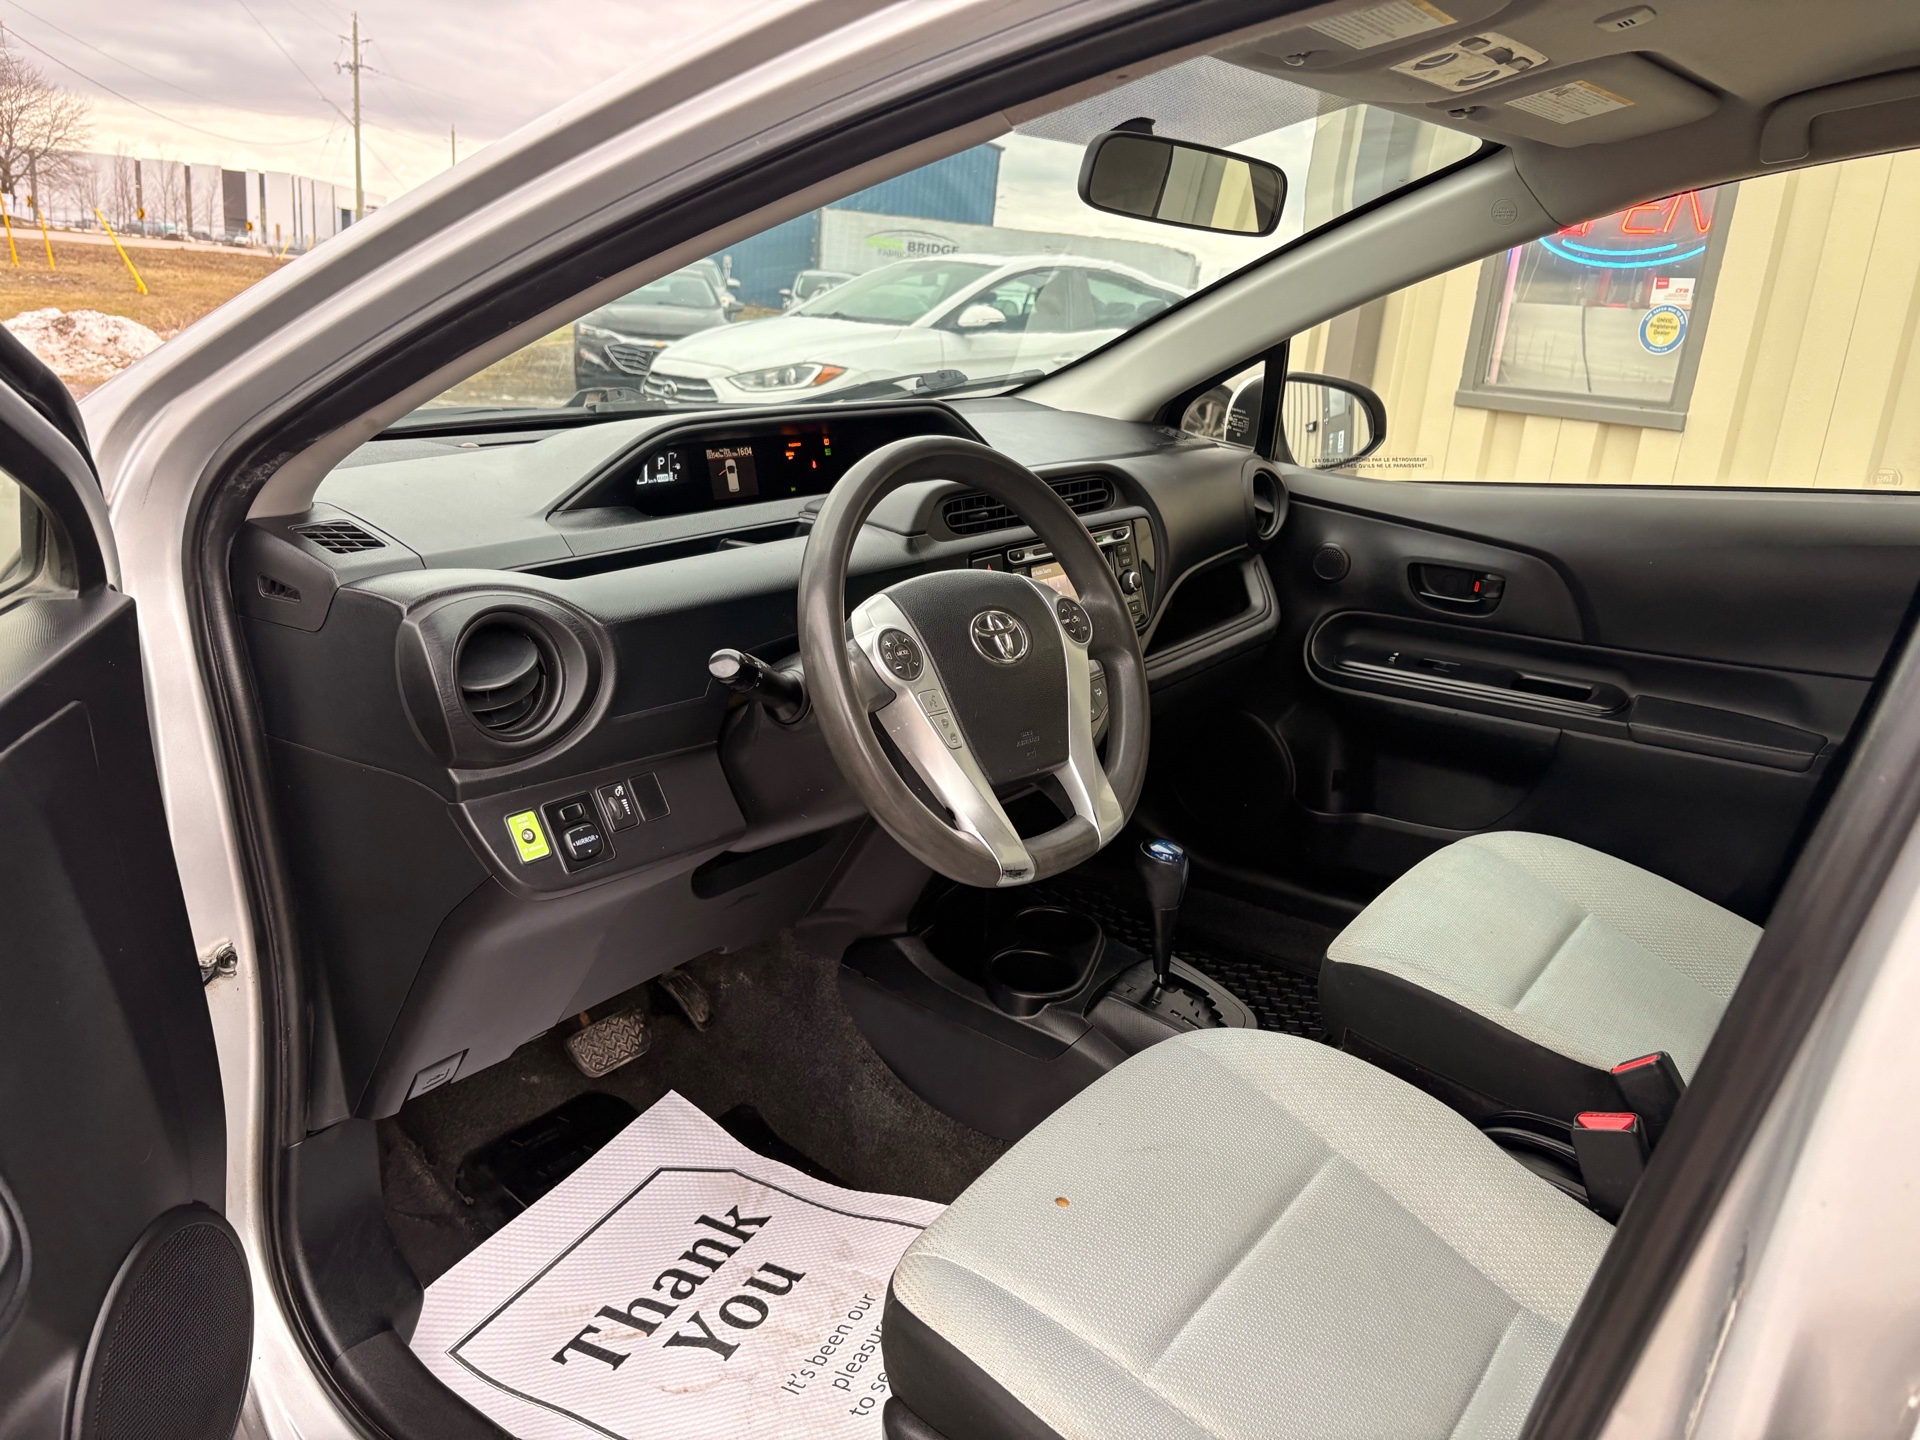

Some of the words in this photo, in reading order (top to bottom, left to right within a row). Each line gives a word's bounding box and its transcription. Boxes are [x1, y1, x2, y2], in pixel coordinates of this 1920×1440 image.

[907, 241, 960, 255] BRIDGE
[1650, 322, 1678, 331] Registered
[657, 456, 666, 470] P
[575, 834, 596, 847] MIRROR
[551, 1204, 773, 1371] Thank
[662, 1261, 807, 1362] You
[804, 1323, 853, 1367] been
[847, 1293, 876, 1321] our
[832, 1322, 882, 1392] pleasur
[849, 1396, 876, 1416] to
[870, 1372, 889, 1393] se
